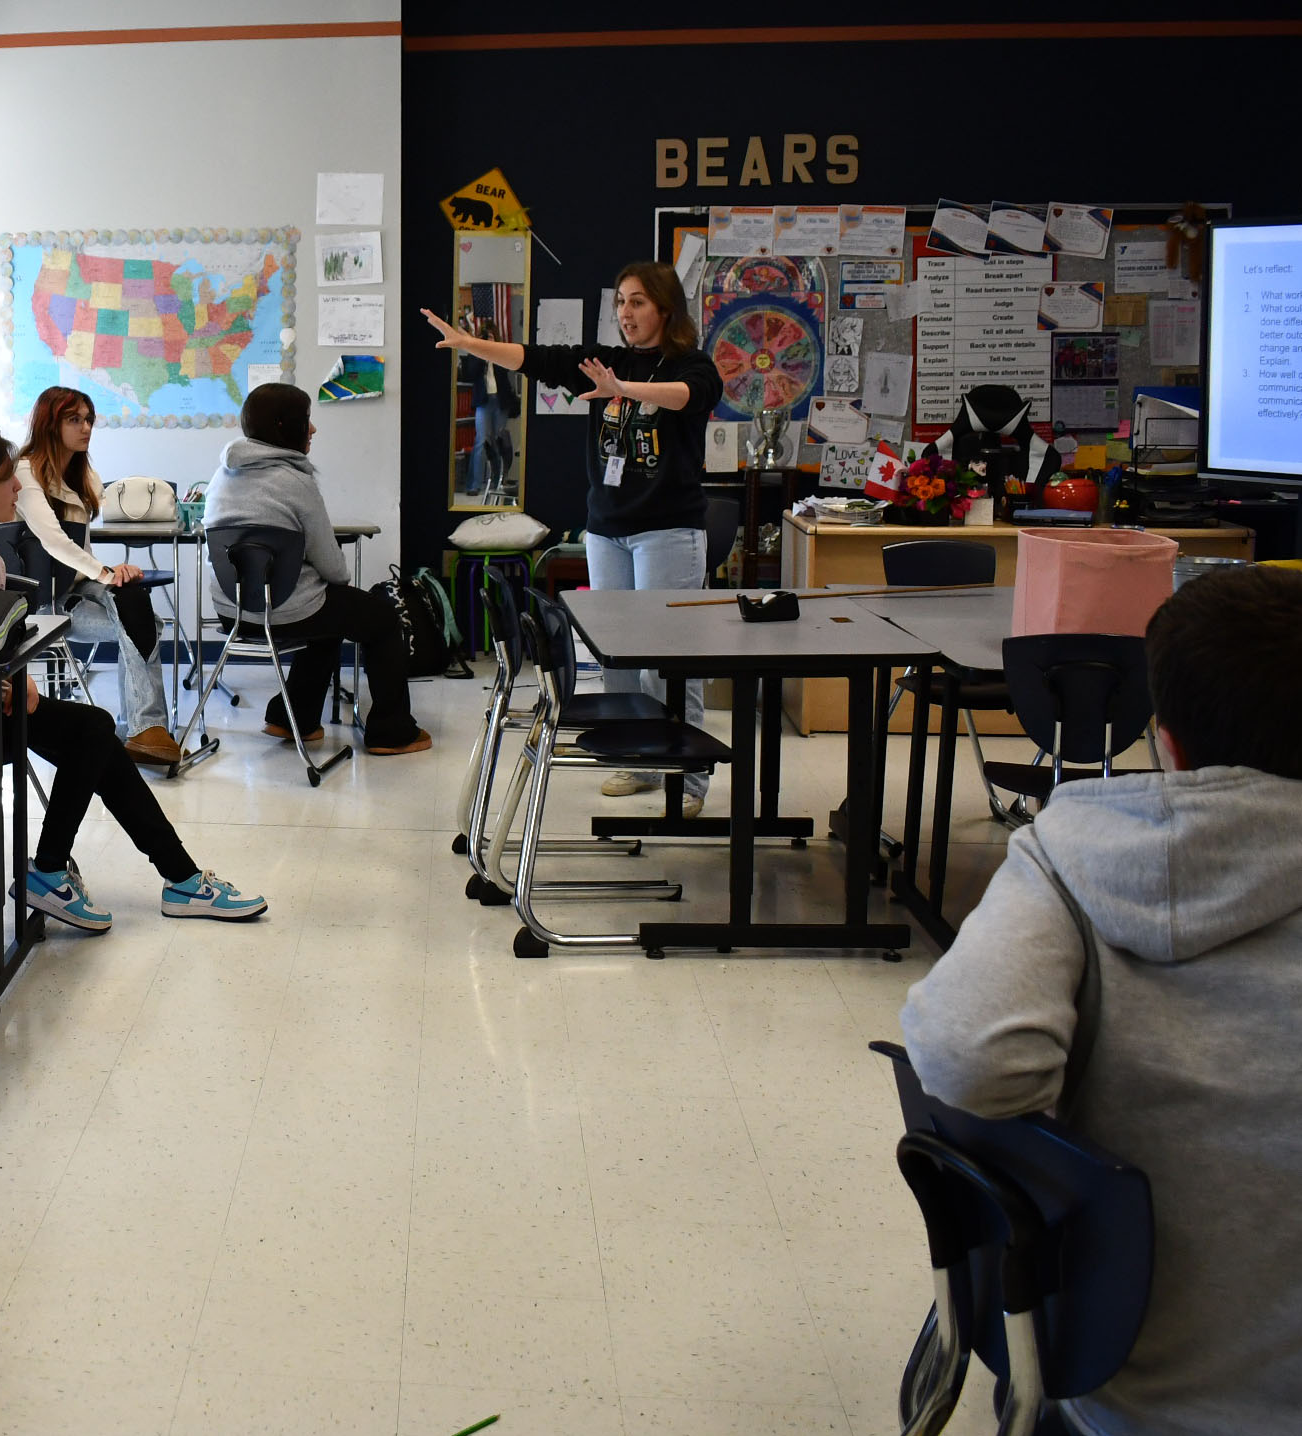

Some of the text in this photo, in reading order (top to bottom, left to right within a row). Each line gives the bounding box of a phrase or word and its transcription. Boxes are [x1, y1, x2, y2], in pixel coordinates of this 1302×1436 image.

[655, 133, 859, 188] BEARS
[475, 183, 507, 200] BEAR
[1243, 264, 1294, 274] Let's reflect:
[1261, 291, 1283, 300] What
[1260, 303, 1283, 313] What
[1260, 317, 1281, 327] done
[921, 329, 951, 337] Describe
[1259, 330, 1284, 340] better
[922, 343, 949, 351] Support
[1259, 343, 1290, 356] change
[923, 357, 948, 365] Explain
[1259, 356, 1292, 367] Explain.
[1259, 369, 1278, 378] How
[1280, 369, 1297, 379] well
[920, 384, 950, 392] Compare
[835, 450, 860, 461] LOVE
